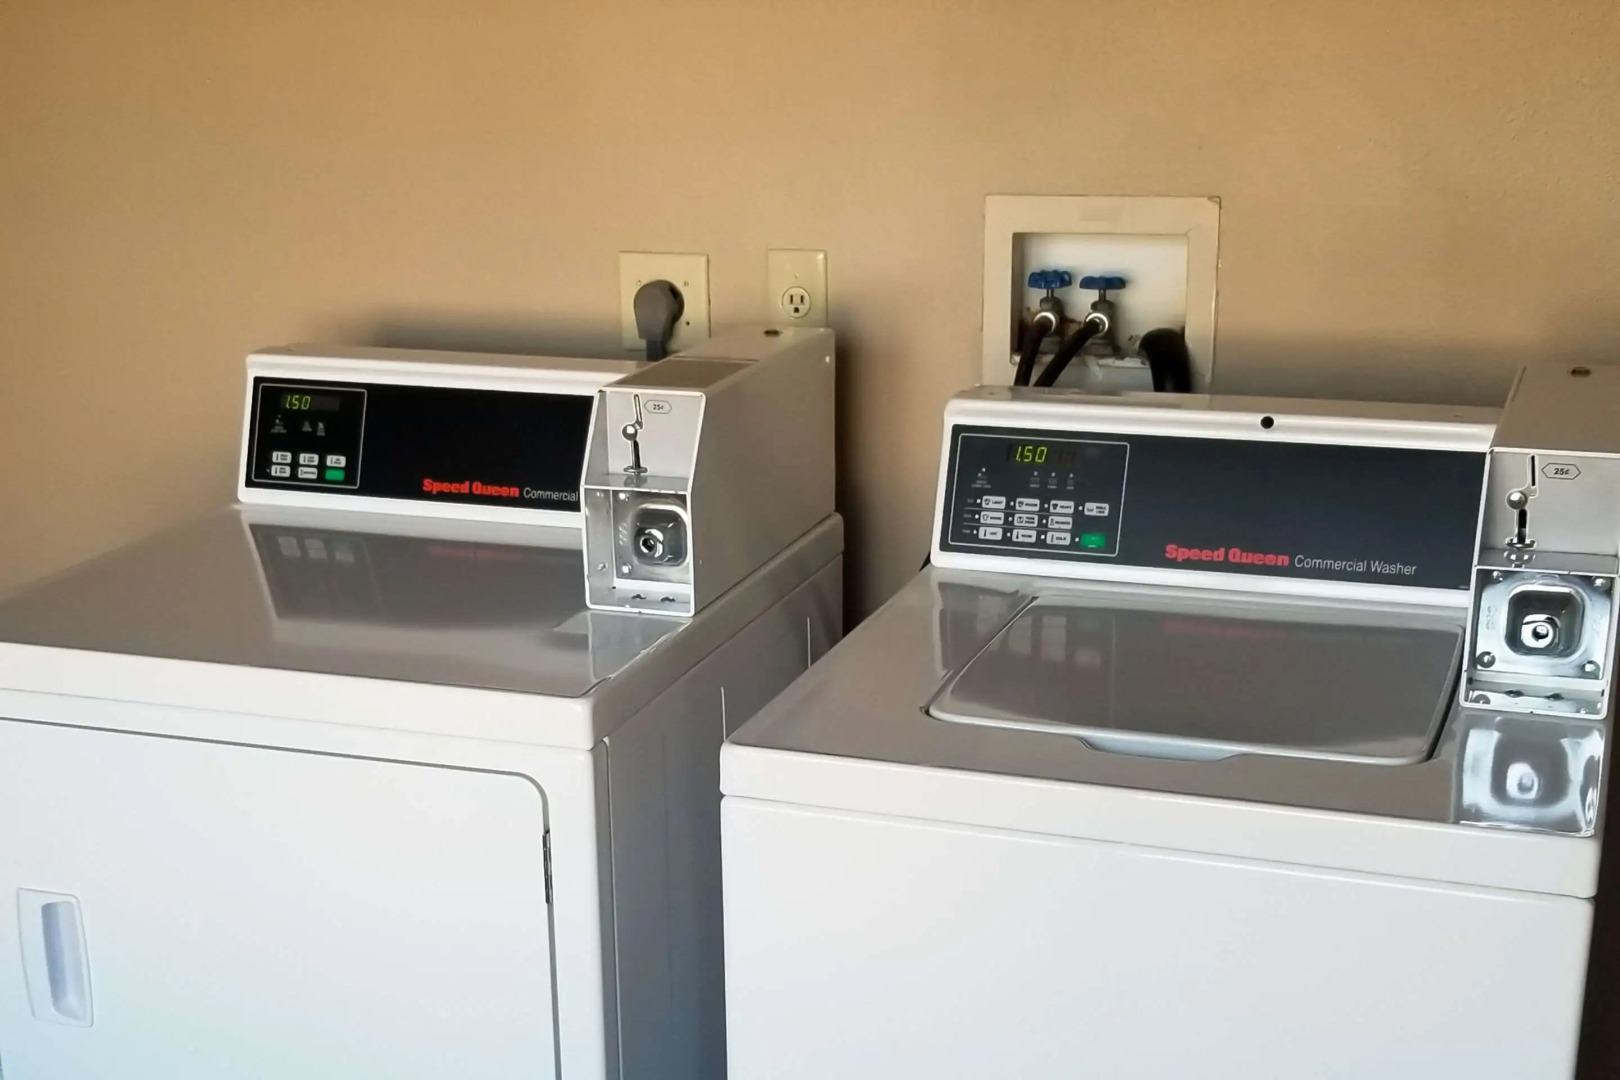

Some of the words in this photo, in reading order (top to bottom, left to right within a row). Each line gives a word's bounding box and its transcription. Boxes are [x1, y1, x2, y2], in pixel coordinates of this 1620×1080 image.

[1016, 446, 1048, 463] 1.50
[1553, 467, 1570, 476] 25¢
[422, 478, 469, 495] Speed
[472, 481, 520, 497] Queen
[523, 487, 578, 501] Commercial
[1165, 544, 1225, 563] Speed
[1228, 548, 1290, 566] Queen
[1294, 554, 1367, 573] Commercial
[1370, 560, 1417, 576] Washer
